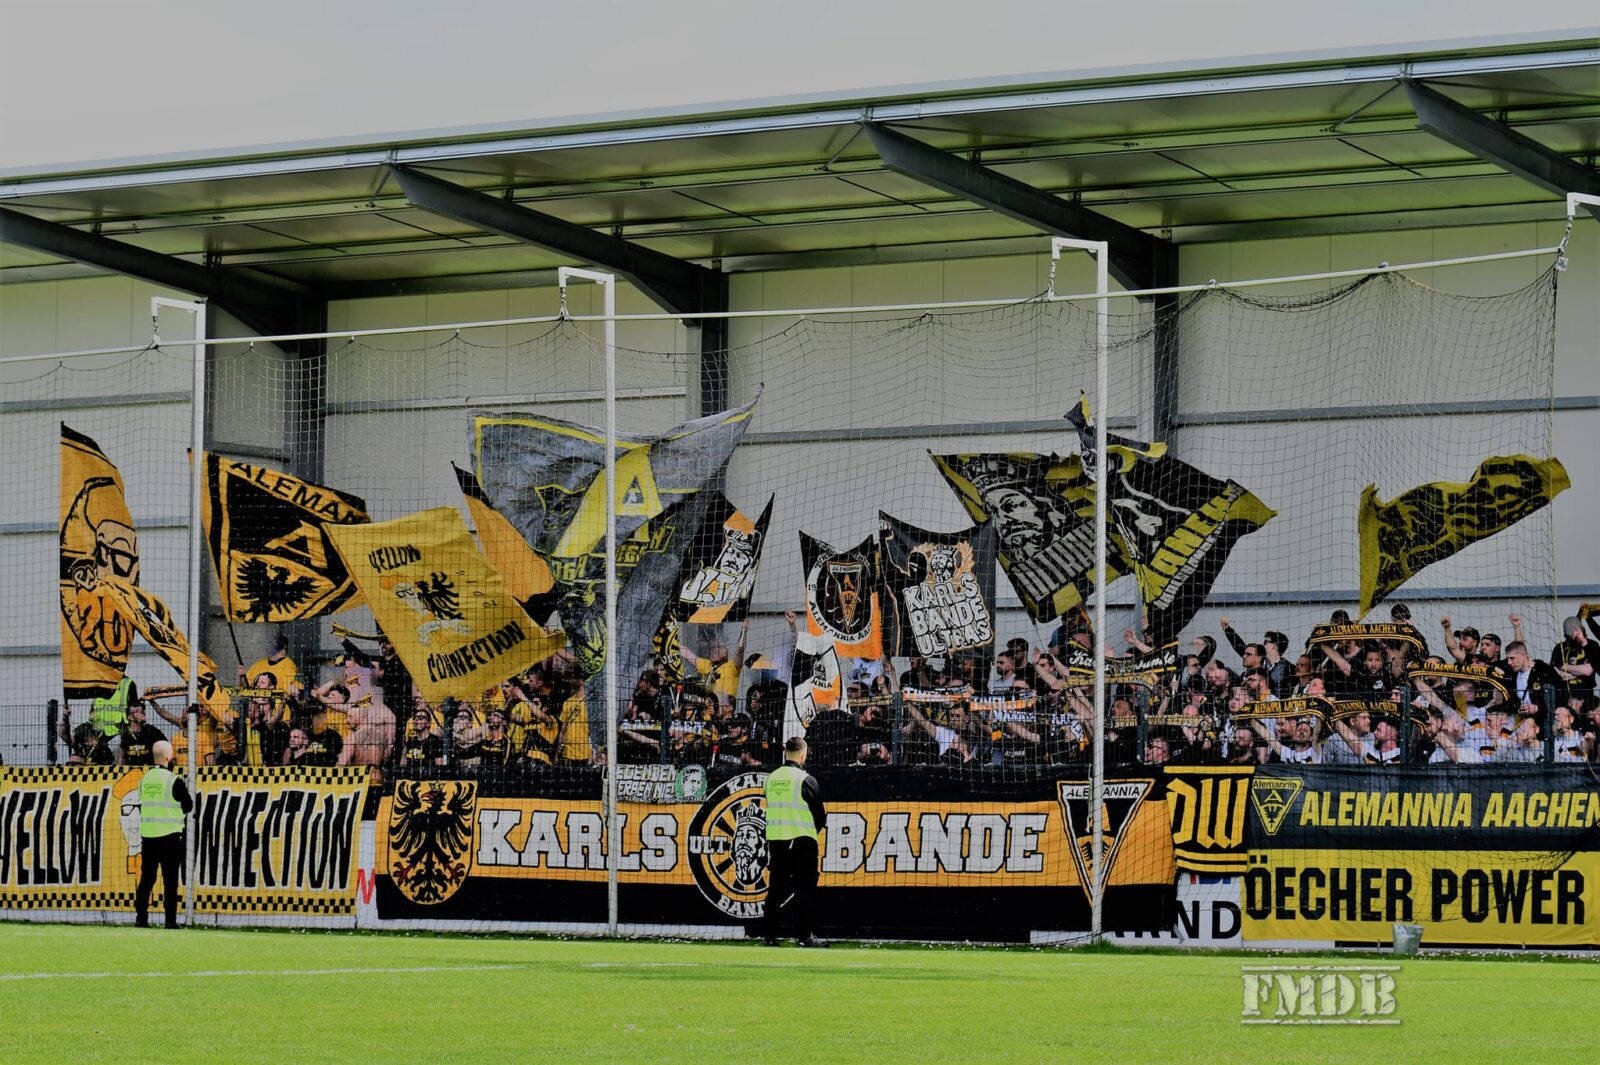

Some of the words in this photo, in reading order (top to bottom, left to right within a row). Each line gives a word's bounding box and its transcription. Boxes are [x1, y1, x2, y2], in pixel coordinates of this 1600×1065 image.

[368, 544, 421, 573] YELLOW
[902, 573, 979, 612] KARLS
[910, 598, 987, 638] BANDE
[1330, 624, 1367, 635] ALEMANNIA
[1369, 624, 1397, 634] AACHEN
[427, 620, 526, 683] CONNECTION
[916, 620, 993, 656] ULTRAS
[1334, 701, 1367, 712] LEMANNIA
[616, 764, 676, 781] EGENDEN
[616, 781, 653, 799] ERBEN
[1253, 780, 1297, 789] Alemannia
[1066, 785, 1140, 797] ALEANNIA
[1300, 791, 1472, 828] ALEMANNIA
[1481, 792, 1600, 828] AACHEN
[195, 788, 360, 889] NNECTION
[477, 809, 678, 871] KARLS
[689, 836, 729, 854] ULT
[822, 812, 1047, 873] BANDE
[1246, 854, 1414, 923] ÖECHER
[1431, 868, 1585, 925] POWER
